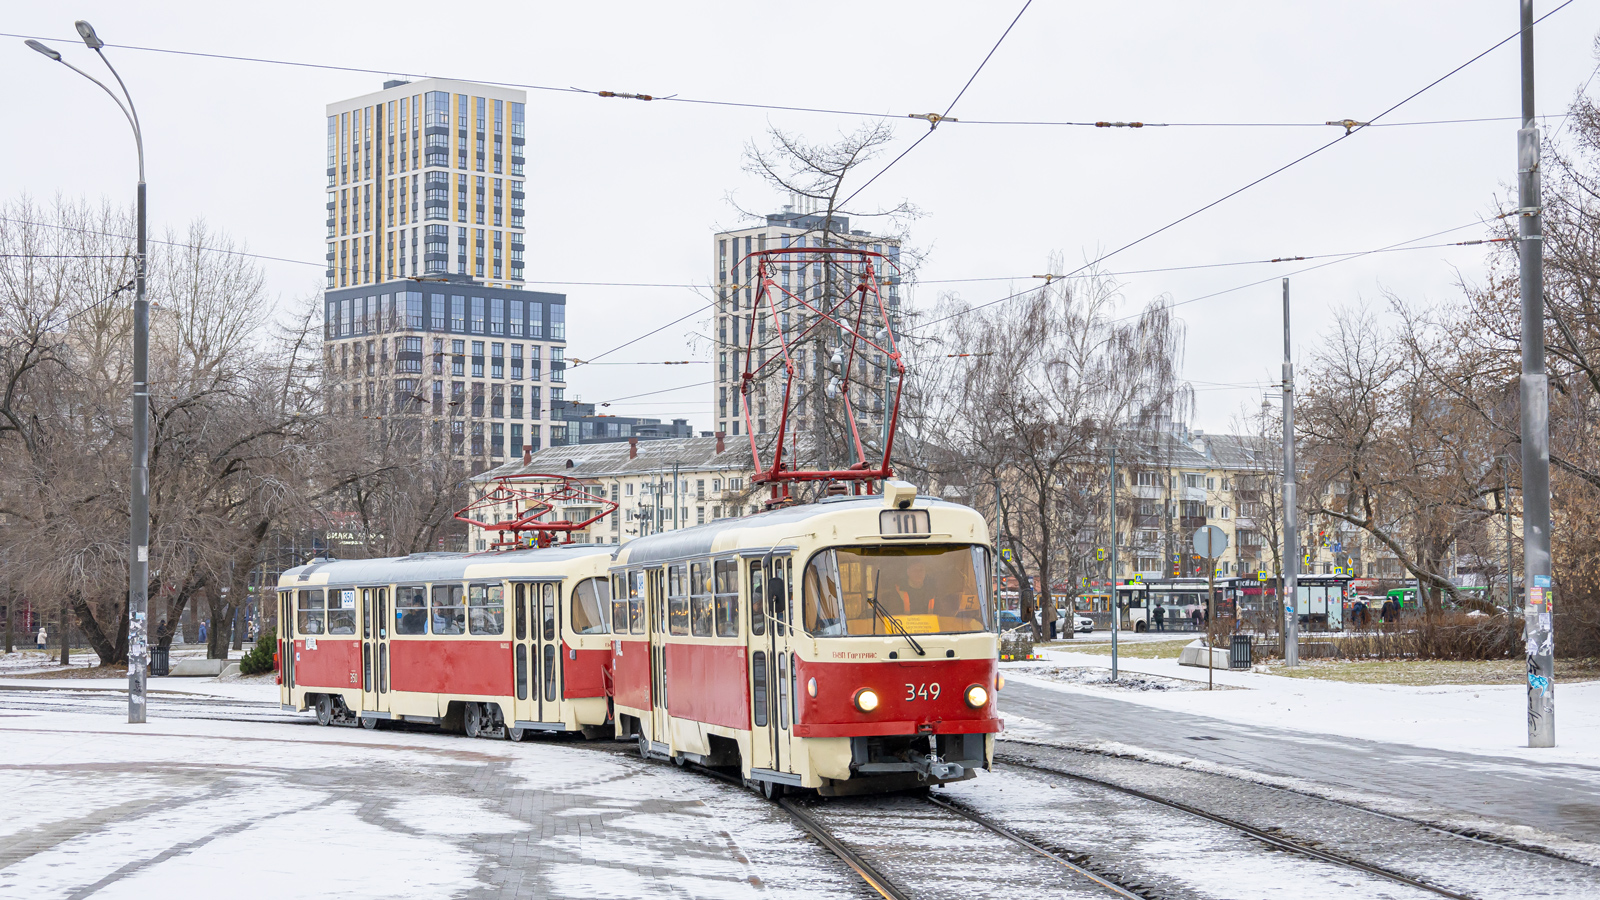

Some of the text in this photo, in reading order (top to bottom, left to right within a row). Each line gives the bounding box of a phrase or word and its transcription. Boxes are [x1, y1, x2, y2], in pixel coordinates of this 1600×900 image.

[893, 514, 917, 534] 10
[344, 592, 353, 602] 350
[905, 682, 941, 702] 349
